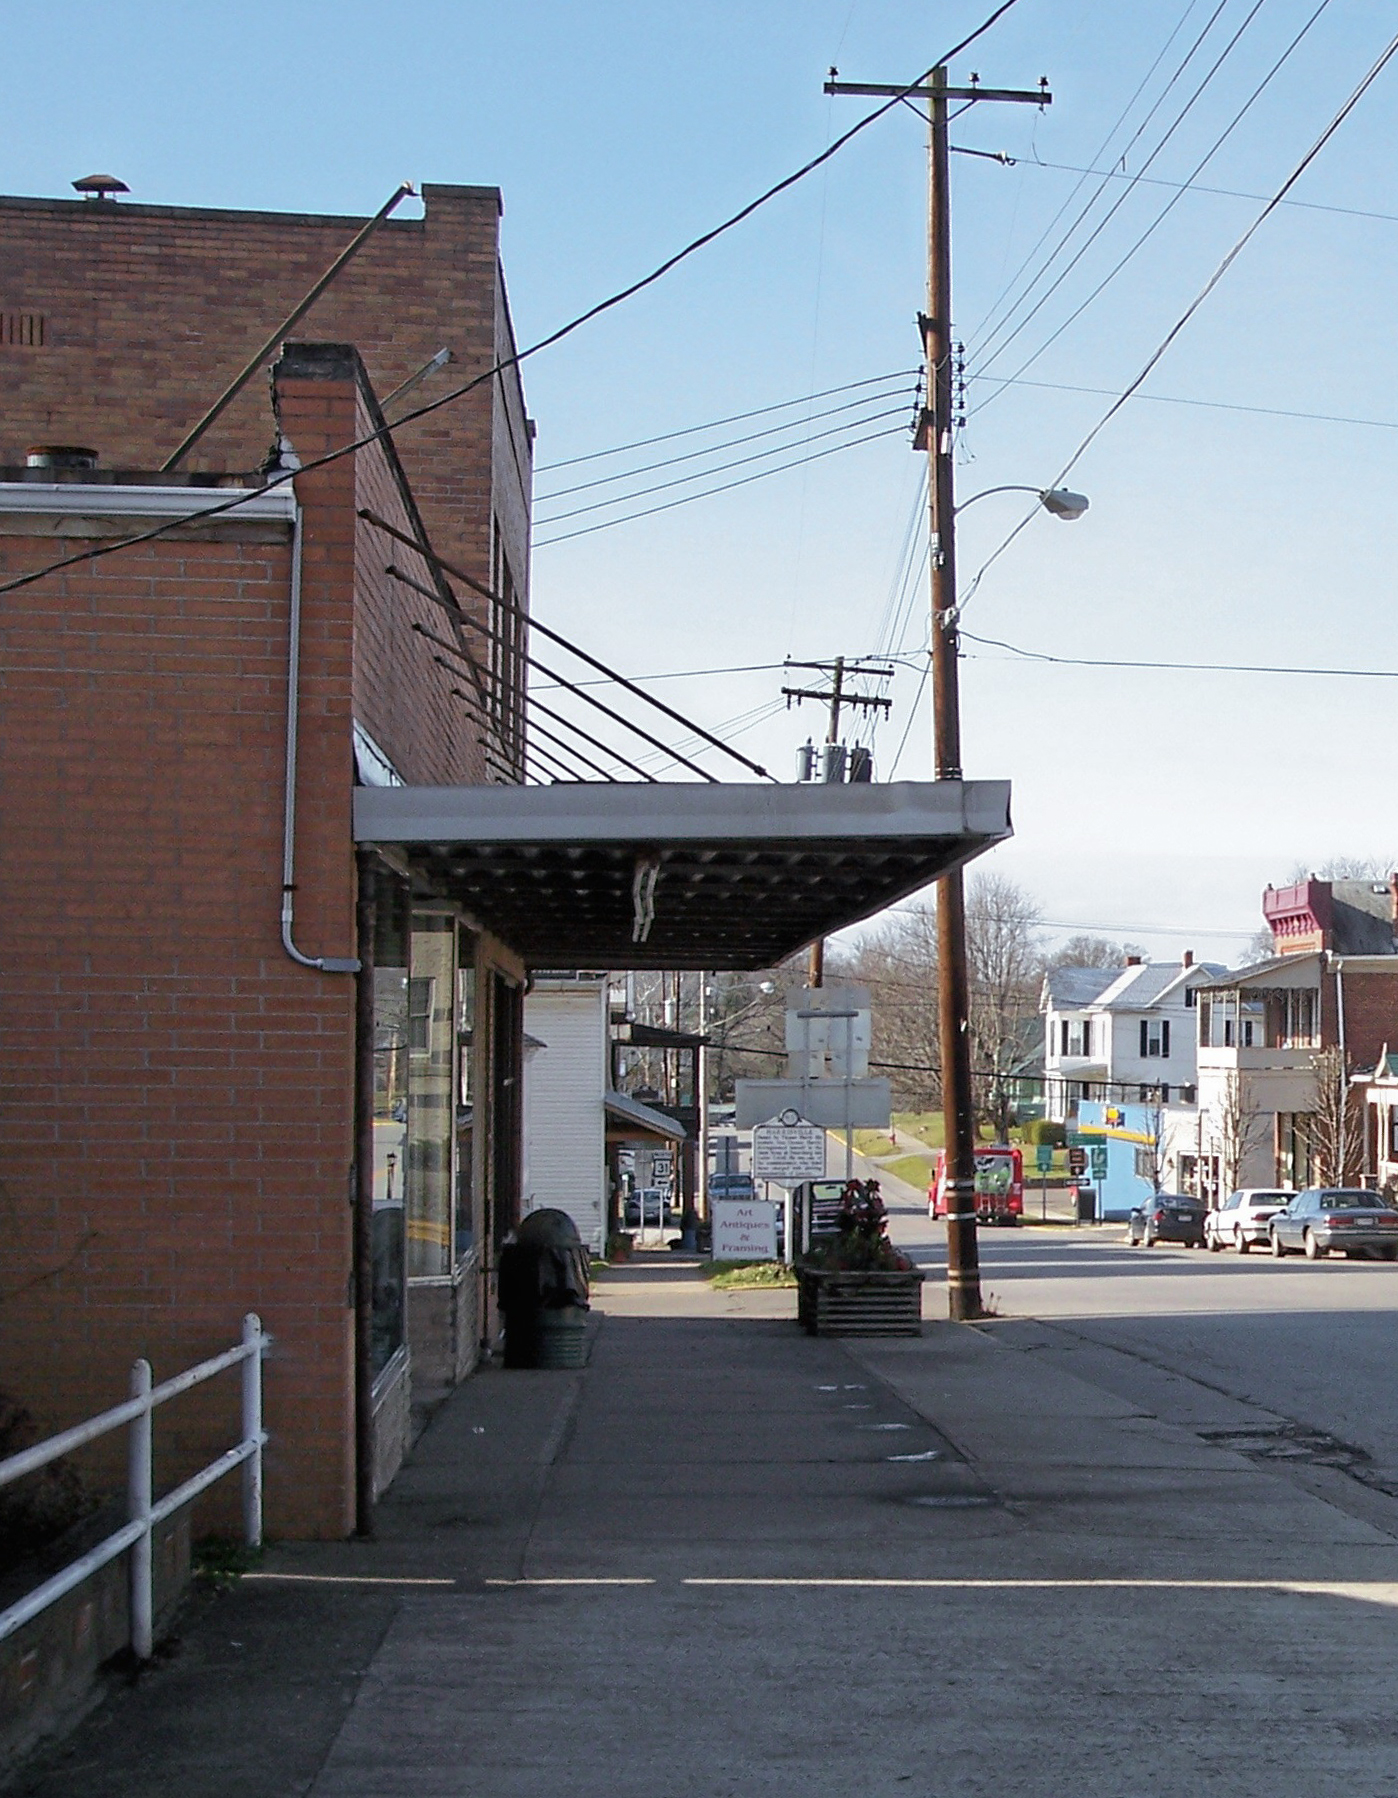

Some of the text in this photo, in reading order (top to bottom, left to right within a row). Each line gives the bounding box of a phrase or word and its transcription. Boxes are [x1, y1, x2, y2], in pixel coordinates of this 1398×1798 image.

[657, 1163, 668, 1173] 31
[736, 1208, 753, 1217] Art
[720, 1220, 770, 1231] Antiques
[721, 1243, 769, 1254] Framing
